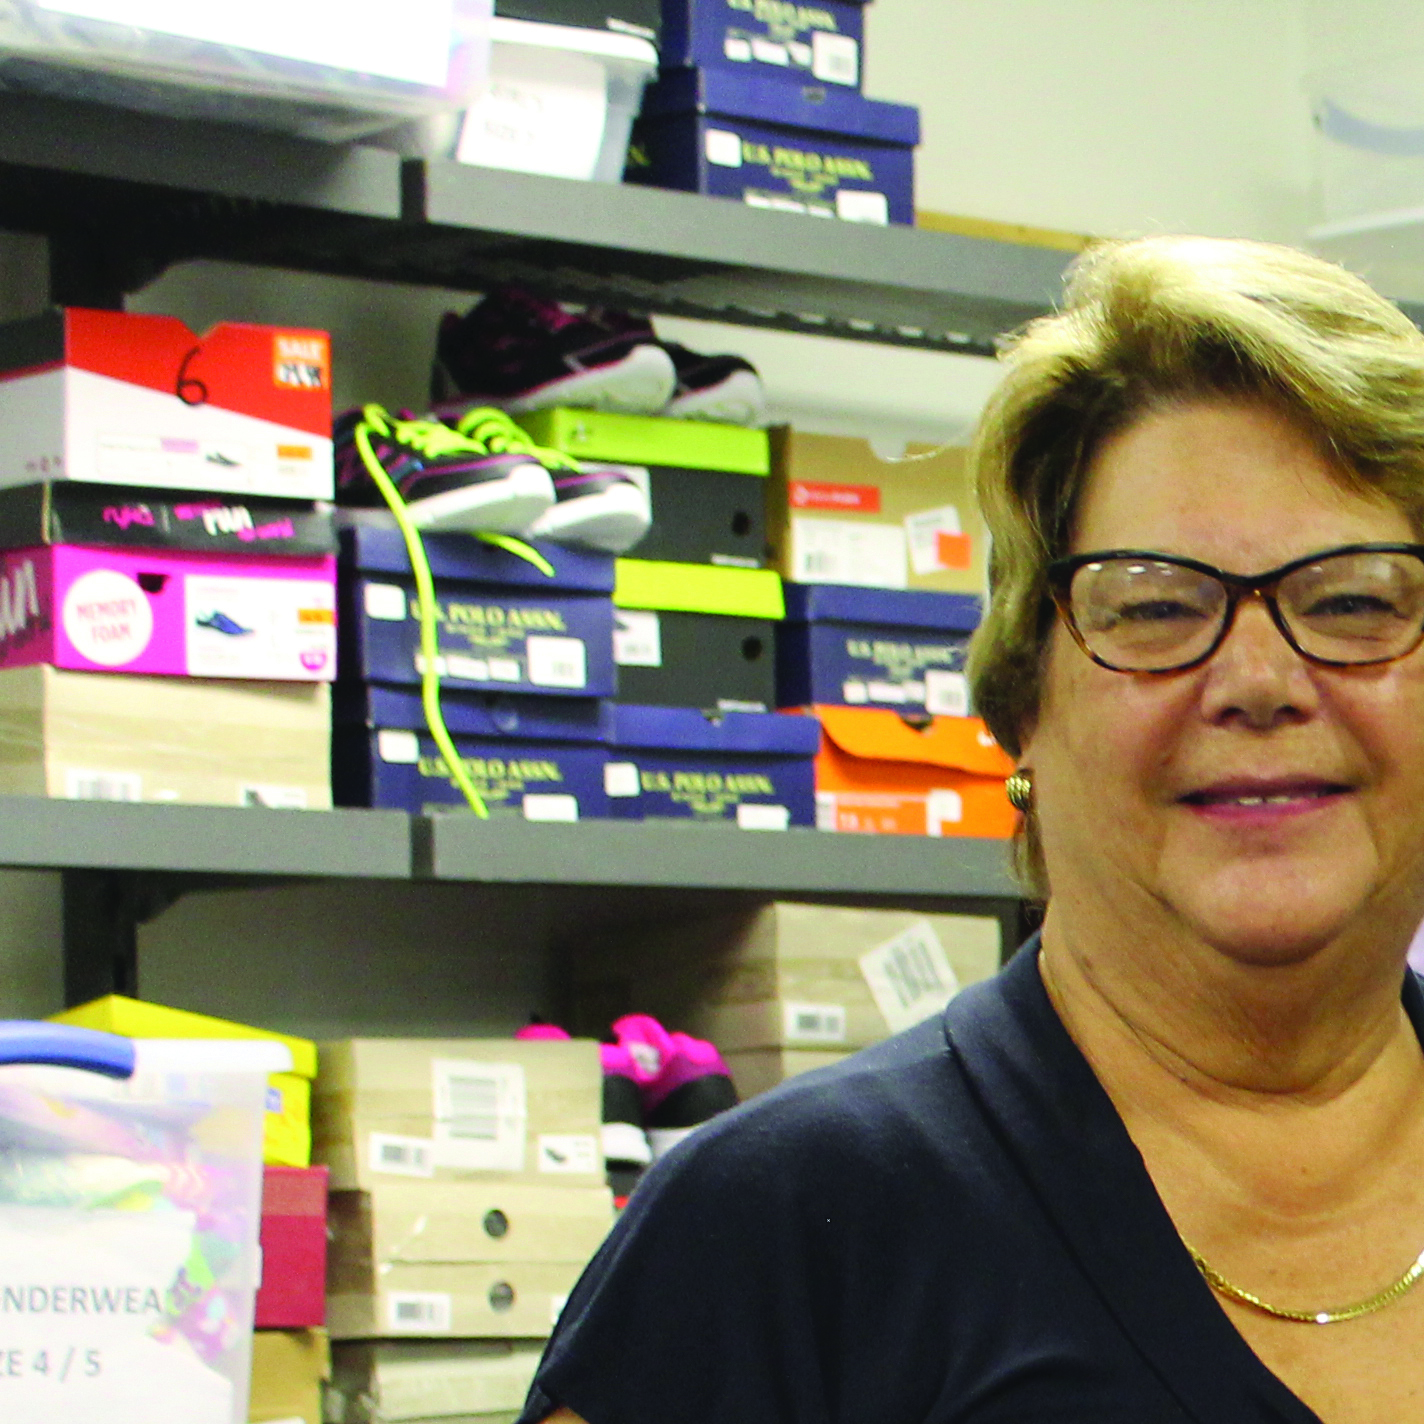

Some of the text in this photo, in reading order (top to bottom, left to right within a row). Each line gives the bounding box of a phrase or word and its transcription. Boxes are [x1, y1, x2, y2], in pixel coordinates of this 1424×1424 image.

[175, 347, 207, 407] 6
[31, 1350, 49, 1376] 4
[58, 1346, 76, 1383] /
[84, 1349, 101, 1377] 5
